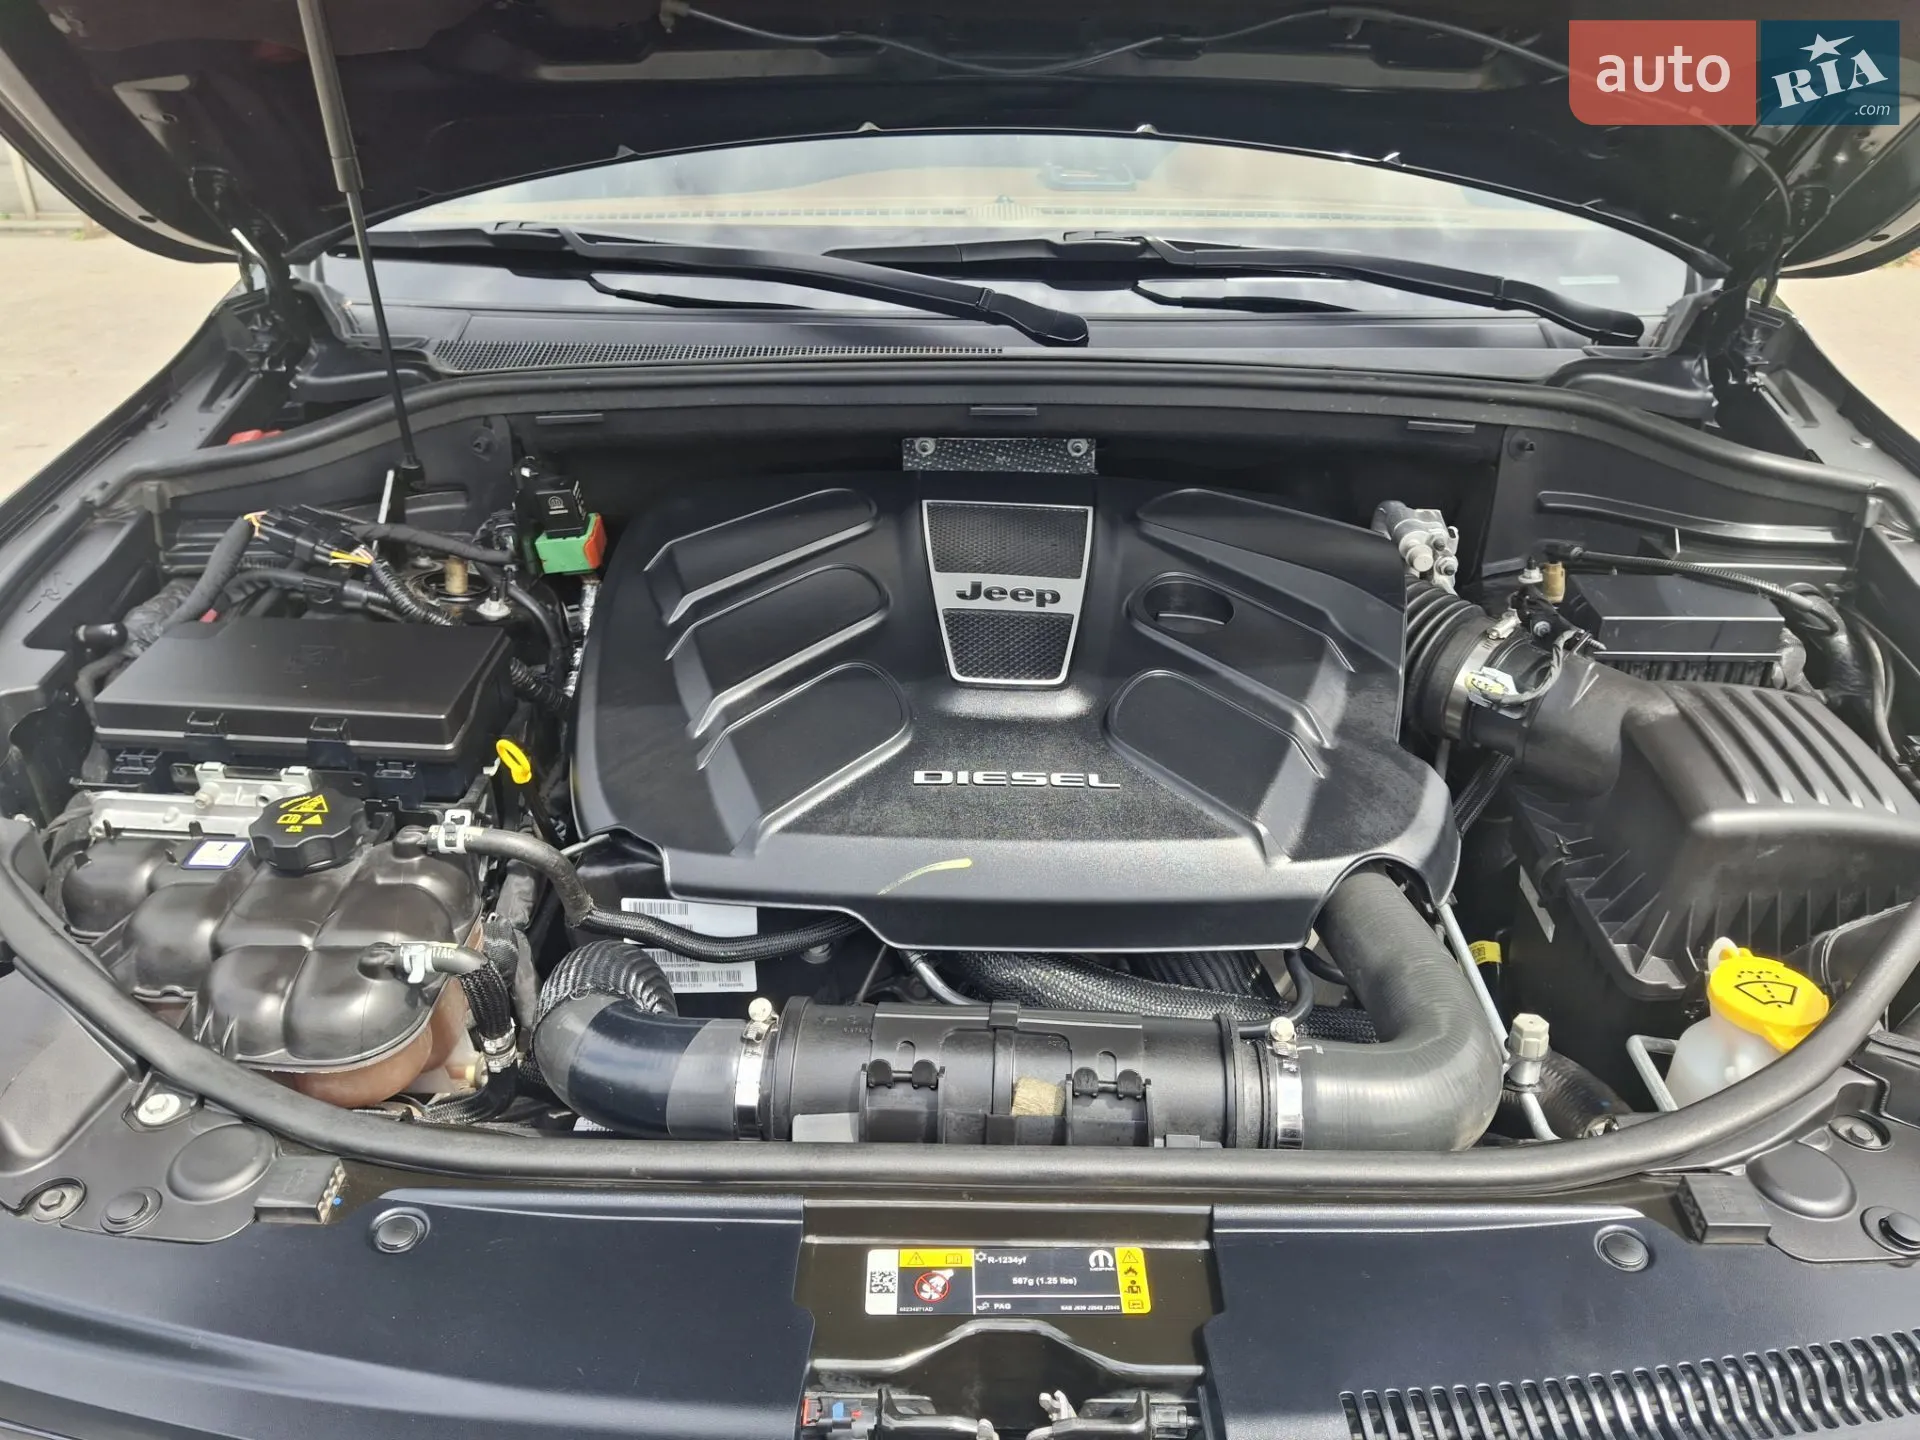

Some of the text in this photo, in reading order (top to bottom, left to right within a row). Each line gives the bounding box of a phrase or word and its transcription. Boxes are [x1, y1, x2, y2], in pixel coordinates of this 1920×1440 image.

[956, 581, 1061, 608] Jeep
[913, 770, 1121, 789] DIESEL
[987, 1255, 1027, 1265] R-1234yf
[1035, 1276, 1059, 1286] (1.25
